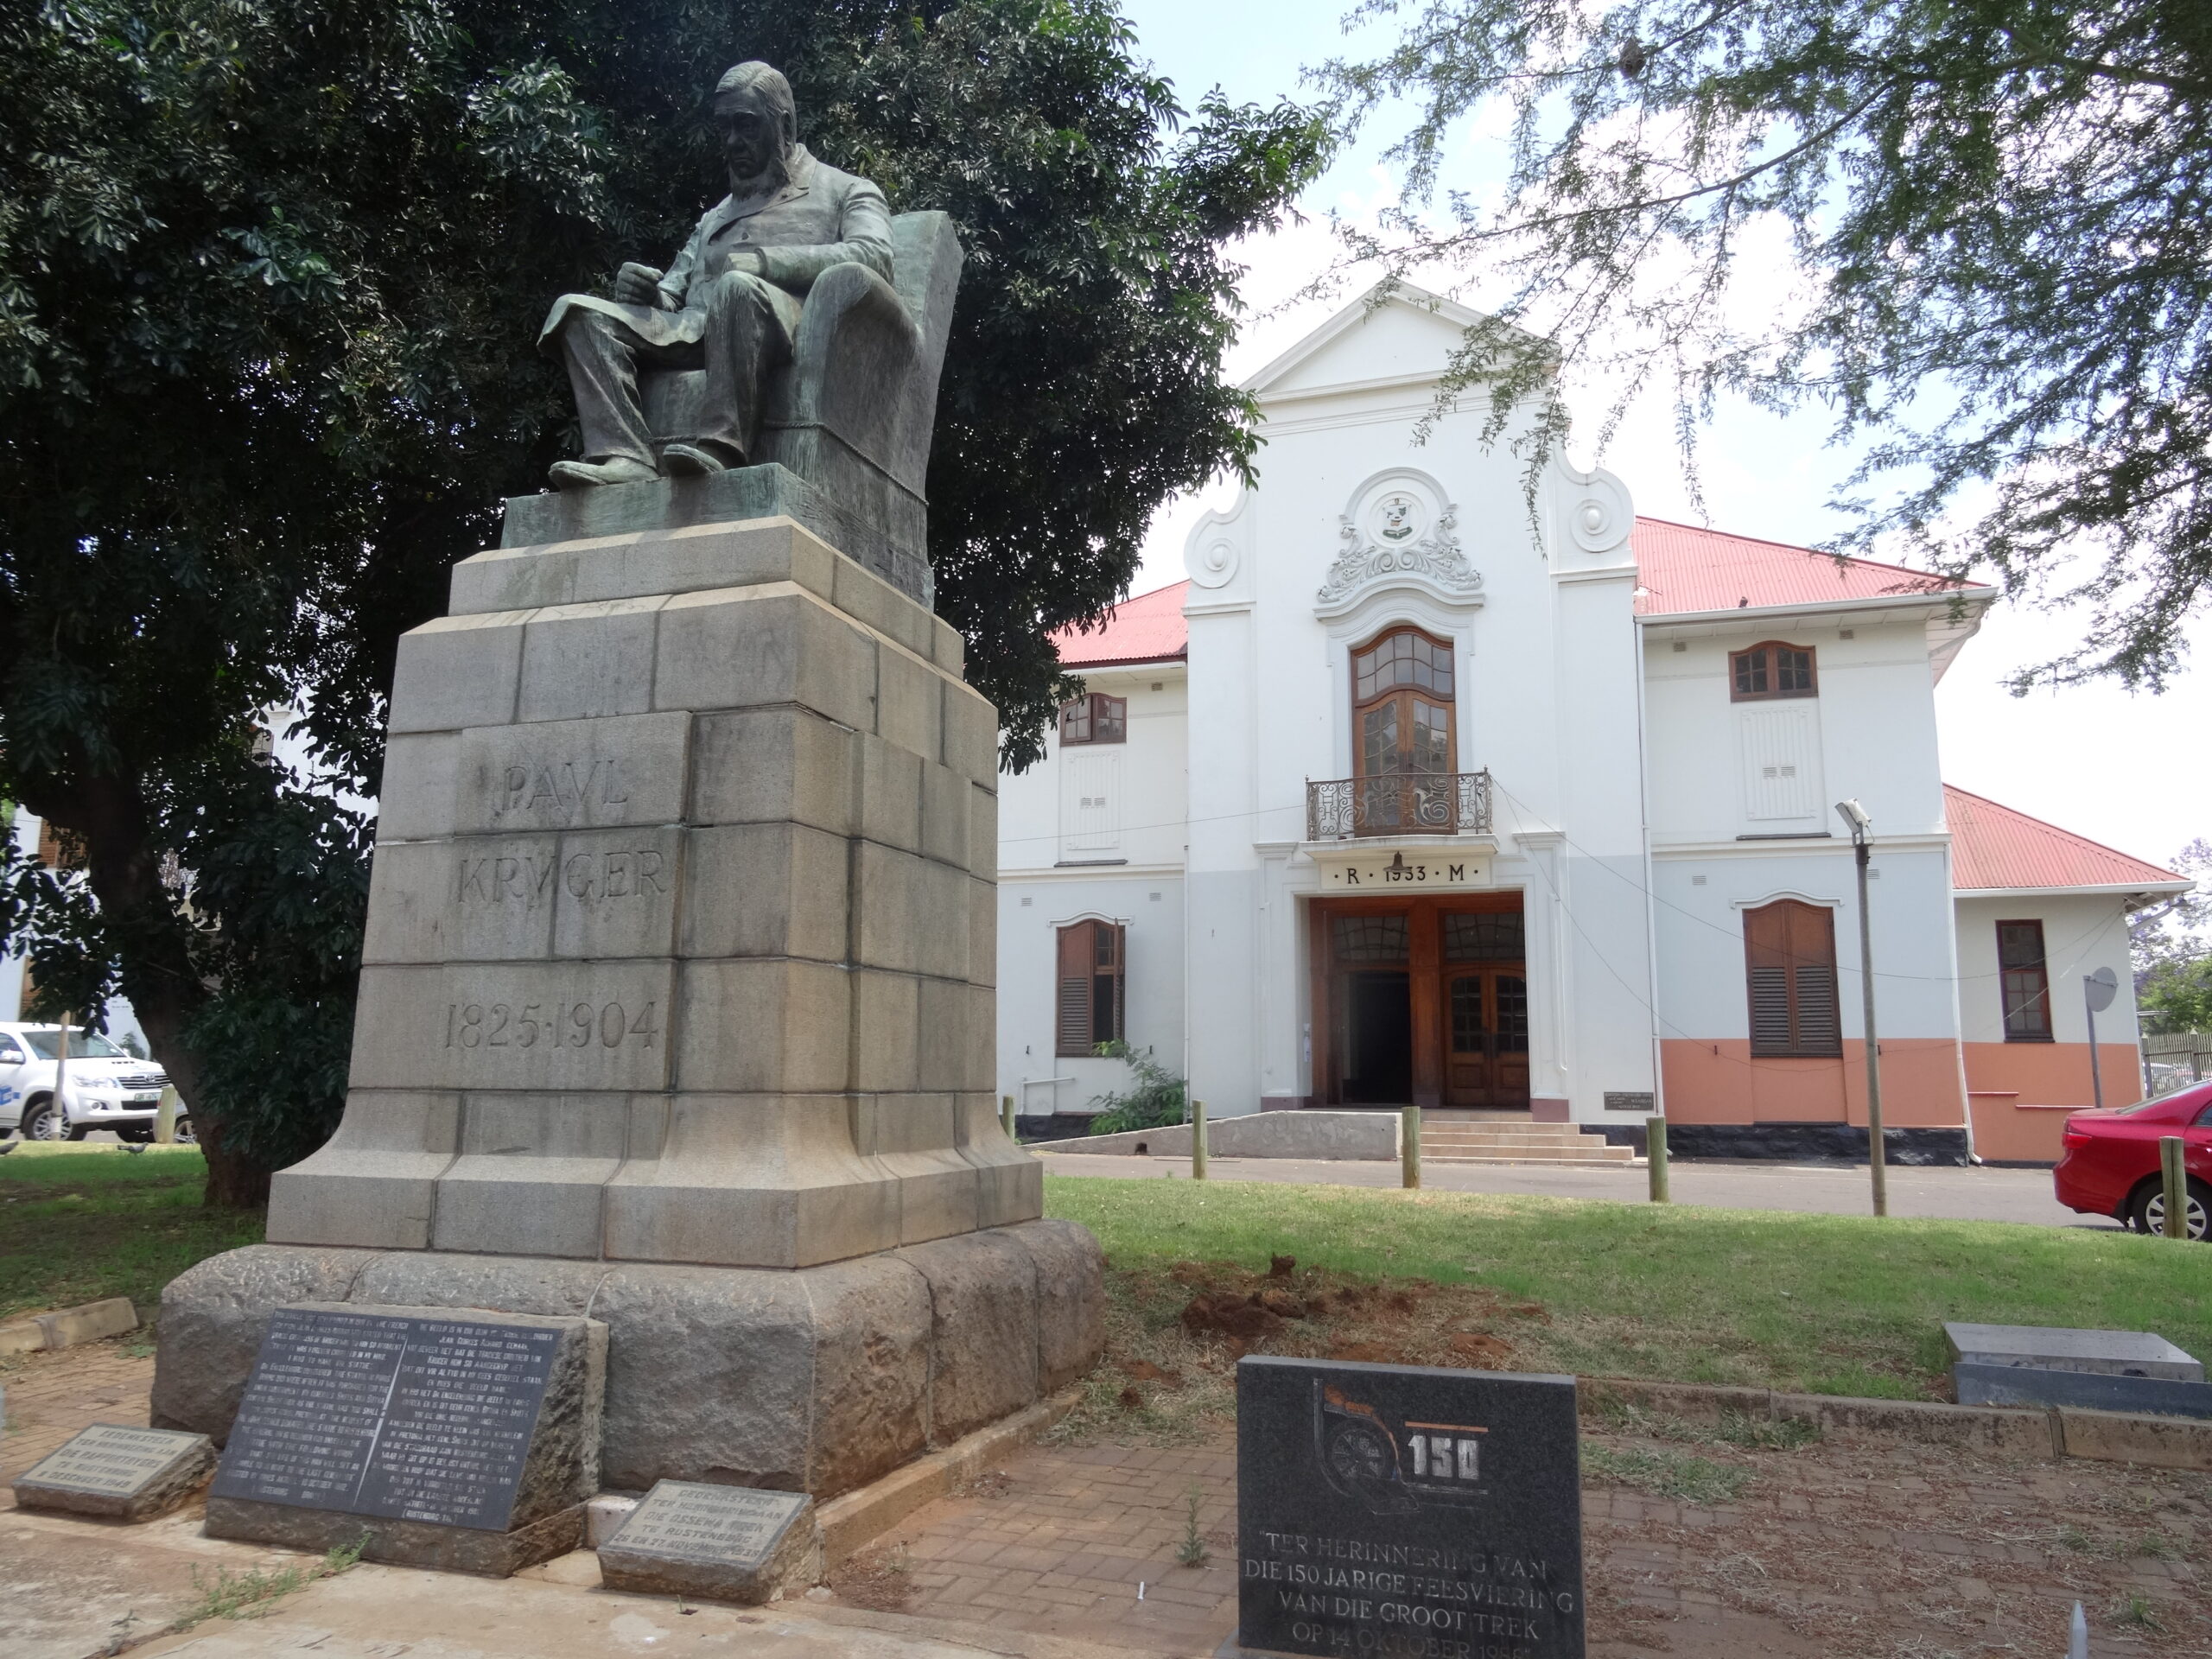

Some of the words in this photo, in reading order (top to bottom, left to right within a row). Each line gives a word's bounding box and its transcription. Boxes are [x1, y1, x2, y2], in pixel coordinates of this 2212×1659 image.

[1347, 868, 1360, 884] R
[1449, 864, 1465, 881] M
[1408, 1435, 1480, 1480] 150
[645, 1511, 668, 1521] DIE
[669, 1514, 724, 1528] OSSEWA
[665, 1528, 751, 1544] RUSTENBURG
[1494, 1554, 1548, 1580] VAN
[1245, 1559, 1282, 1580] DIE
[1288, 1565, 1319, 1584] 150
[1324, 1567, 1406, 1594] JARIGE
[1412, 1576, 1573, 1613] FEESVIERING
[1279, 1591, 1327, 1615] VAN
[1335, 1598, 1372, 1619] DIE
[1380, 1602, 1466, 1631] GROOT
[1473, 1612, 1539, 1640] TREK
[1293, 1622, 1323, 1643] OP
[1328, 1628, 1350, 1647] 14
[1357, 1629, 1471, 1659] OKTOBER
